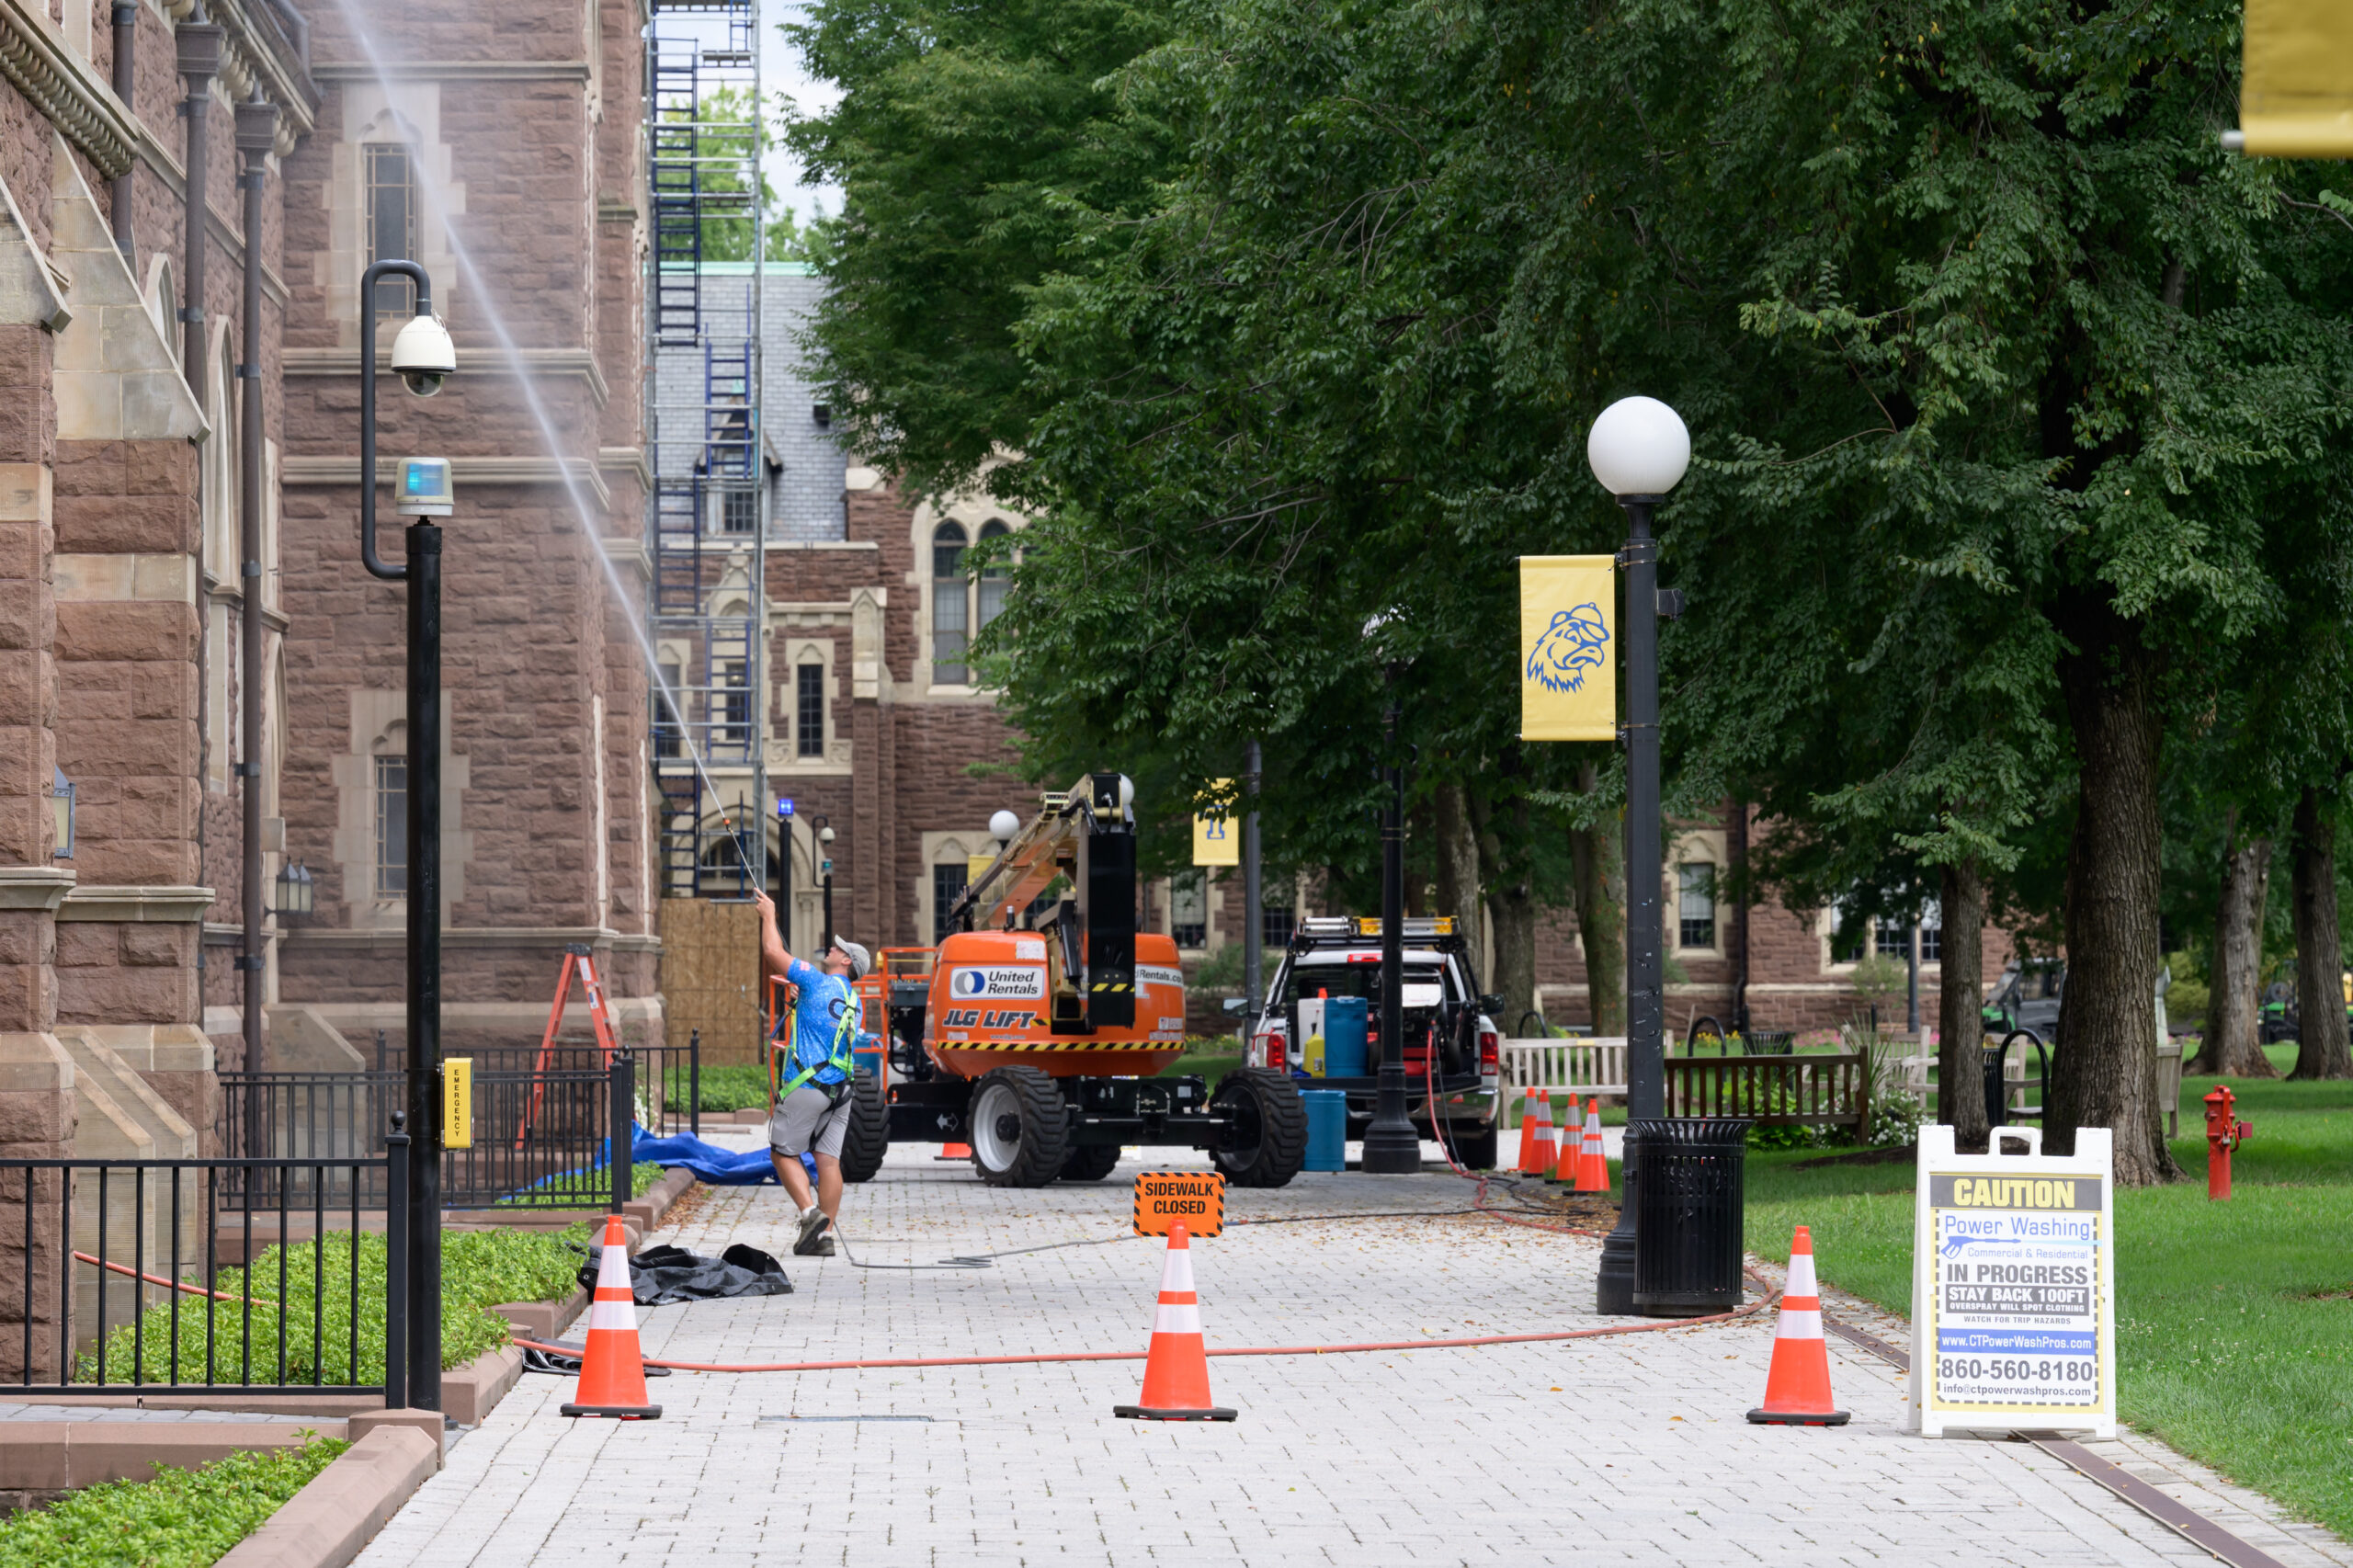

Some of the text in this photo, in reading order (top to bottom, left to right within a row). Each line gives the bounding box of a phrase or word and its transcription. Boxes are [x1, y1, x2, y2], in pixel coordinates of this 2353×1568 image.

[989, 971, 1035, 983] United
[987, 983, 1038, 994] Rentals
[942, 1009, 1037, 1028] JLG LIFT
[1145, 1182, 1214, 1196] SIDEWALK
[1954, 1178, 2075, 1208] CAUTION
[1154, 1200, 1206, 1213] CLOSED
[1945, 1215, 2090, 1241] Power Washing
[1968, 1247, 2088, 1259] Commercial & Residential
[1947, 1264, 2087, 1285] IN PROGRESS
[1949, 1287, 2085, 1303] STAY BACK 100FT
[1949, 1302, 1997, 1311] OVERSPRAY
[2022, 1303, 2043, 1312] SPOT
[2045, 1304, 2085, 1312] CLOTHING
[1941, 1335, 2092, 1349] www.CTPowerWashPros.com
[1941, 1358, 2093, 1381] 860-560-8180
[1943, 1383, 2091, 1397] info@ctpowerwashpros.com
